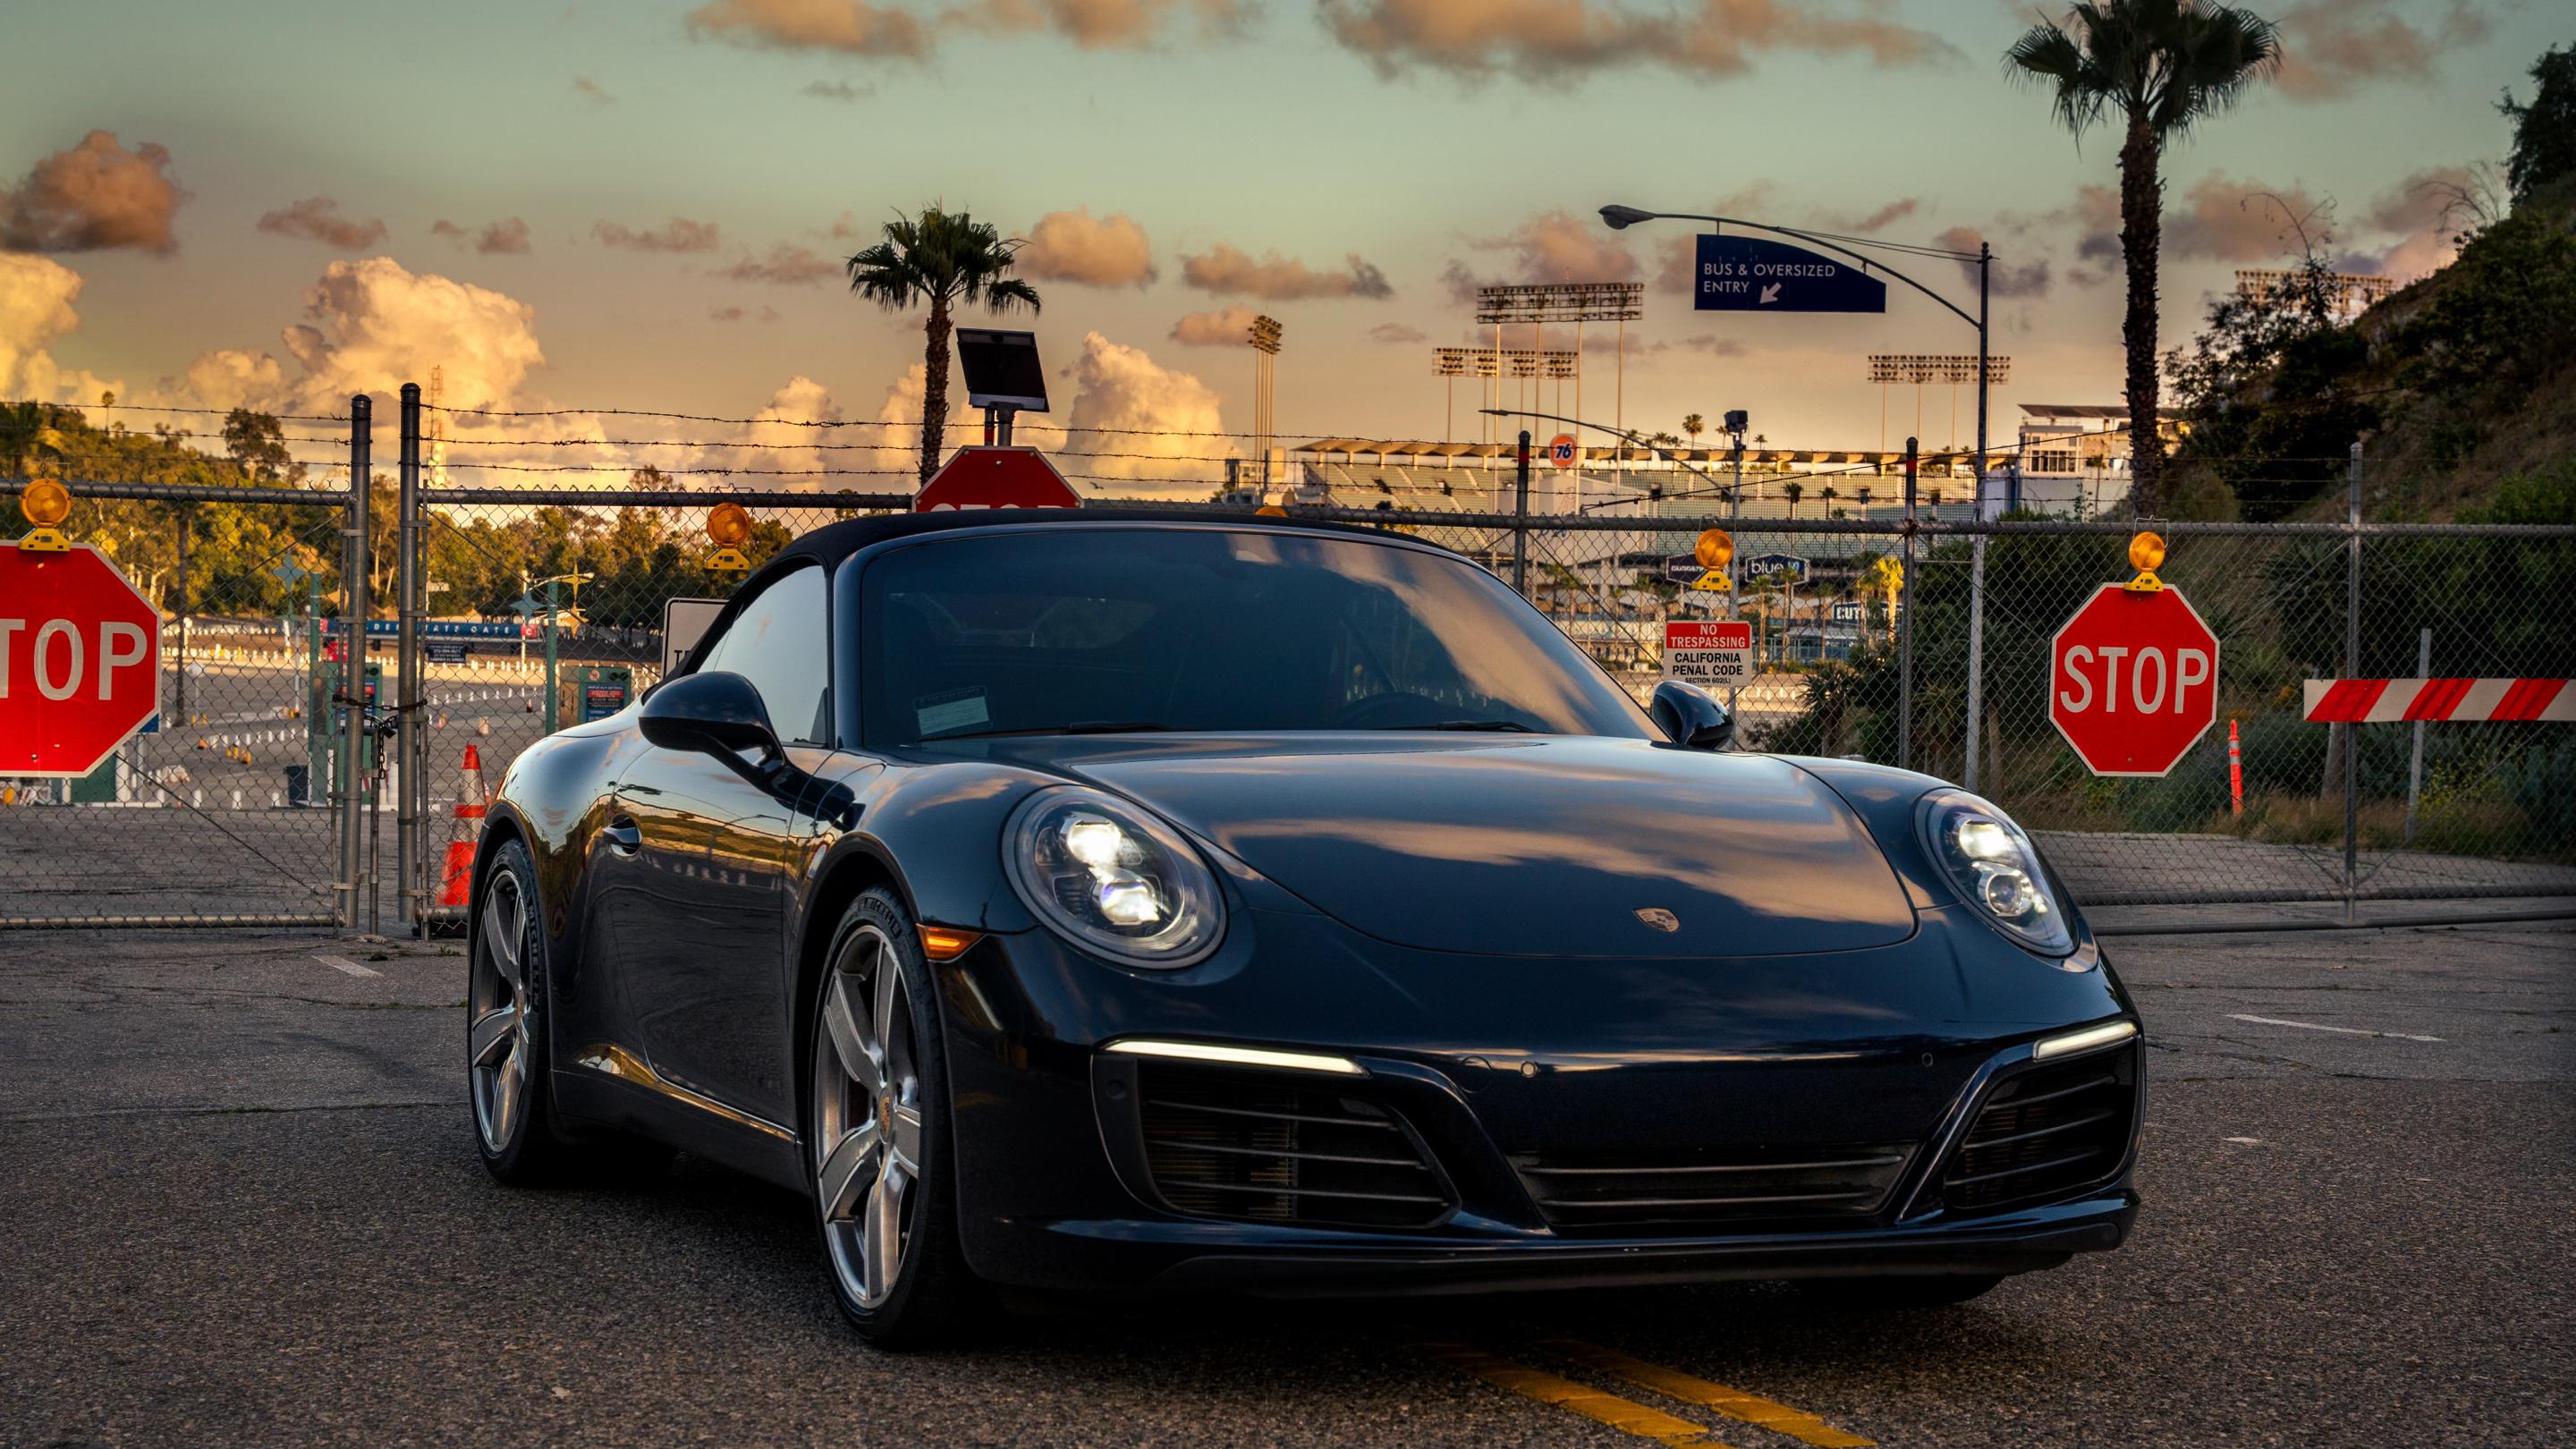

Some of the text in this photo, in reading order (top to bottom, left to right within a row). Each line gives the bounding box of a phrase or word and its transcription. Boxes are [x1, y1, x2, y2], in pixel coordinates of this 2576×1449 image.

[1704, 263, 1835, 276] BUS & OVERSIZED
[1704, 281, 1750, 293] ENTRY
[1555, 443, 1572, 459] 76
[1700, 624, 1717, 635] NO
[1671, 637, 1746, 648] TRESPASSING
[0, 618, 148, 701] TOP
[1674, 652, 1741, 663] CALIFORNIA
[1673, 665, 1743, 675] PENAL CODE
[2060, 645, 2209, 715] STOP
[527, 903, 540, 1006] MICHELIN
